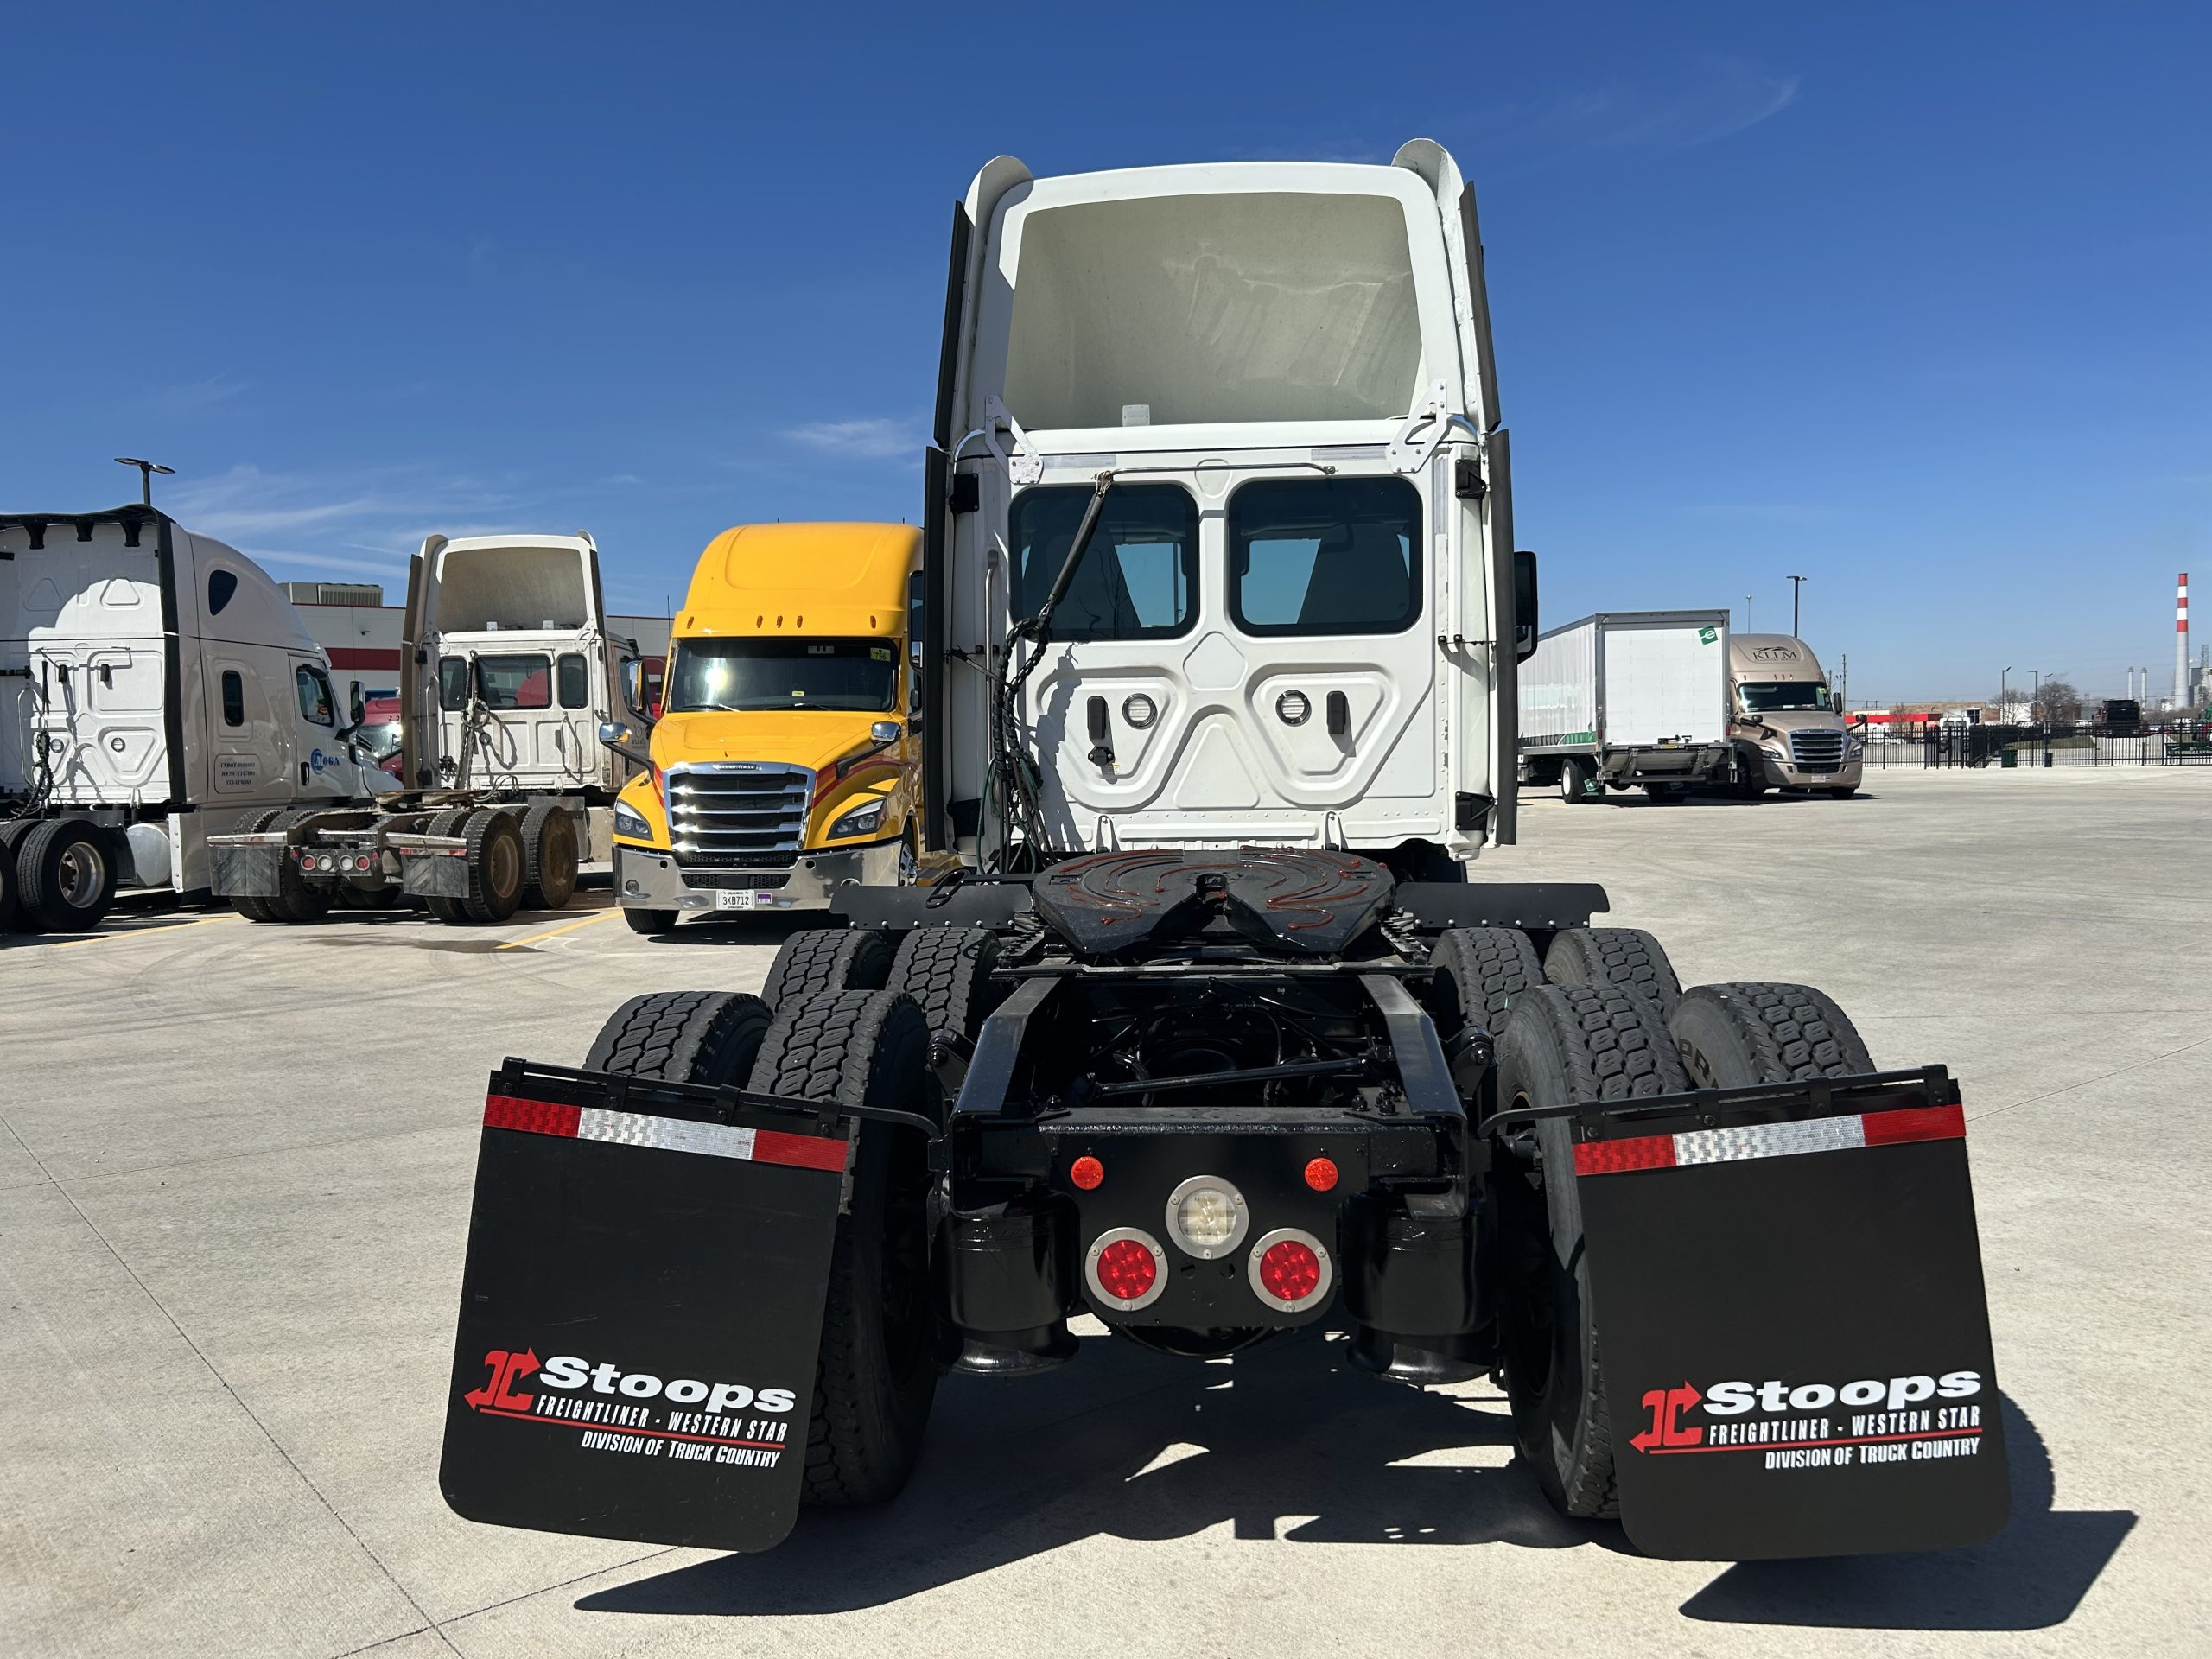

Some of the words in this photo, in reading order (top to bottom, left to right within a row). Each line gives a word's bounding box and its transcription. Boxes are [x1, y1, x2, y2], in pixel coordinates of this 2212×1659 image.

[539, 1356, 797, 1414] Stoops
[1702, 1370, 1981, 1415] Stoops
[536, 1395, 651, 1428] FREIGHTLINER
[667, 1411, 743, 1439] WESTERN
[747, 1420, 788, 1442] STAR
[1709, 1417, 1830, 1446] FREIGHTLINER
[1851, 1409, 1930, 1437] WESTERN
[1937, 1405, 1980, 1430] STAR
[581, 1431, 645, 1455] DIVISION
[645, 1438, 664, 1457] OF
[668, 1440, 714, 1463] TRUCK
[715, 1446, 781, 1469] COUNTRY
[1764, 1448, 1831, 1470] DIVISION
[1834, 1446, 1853, 1466] OF
[1858, 1443, 1908, 1465] TRUCK
[1911, 1437, 1980, 1460] COUNTRY
